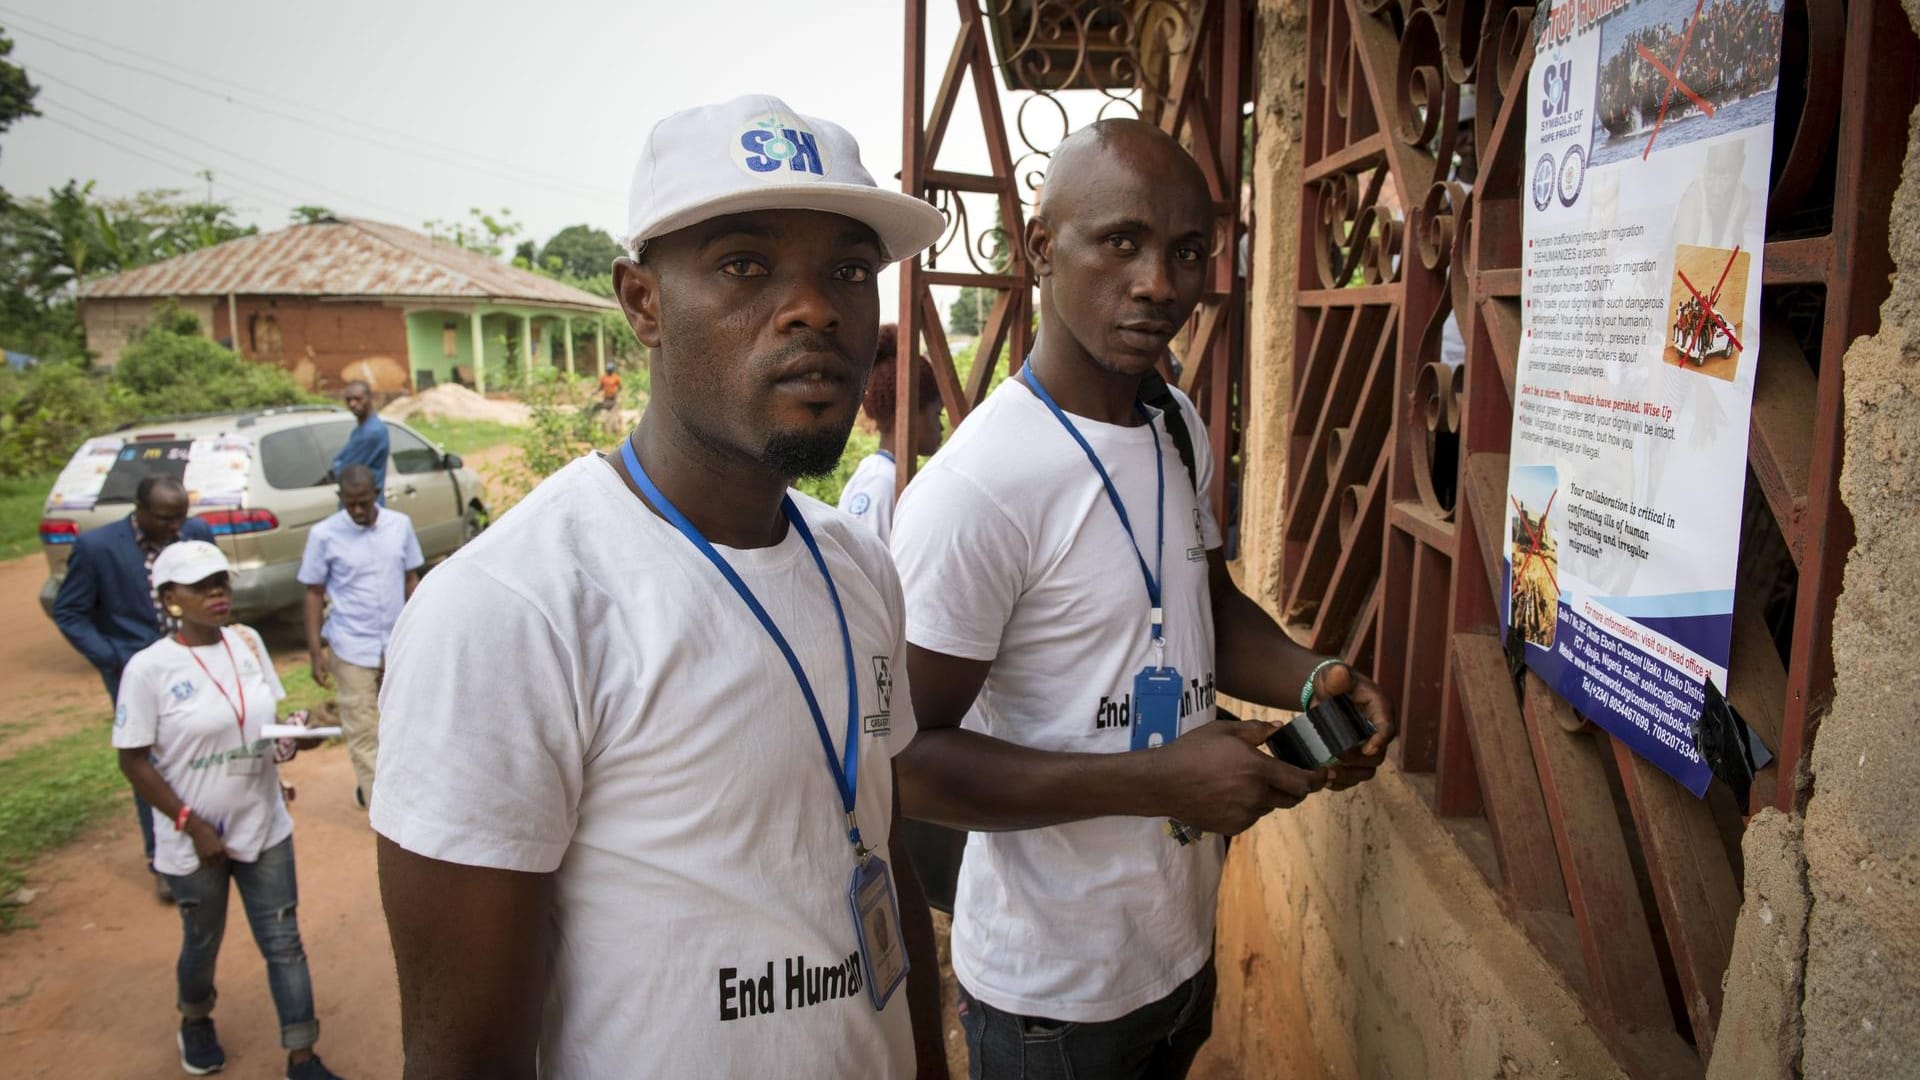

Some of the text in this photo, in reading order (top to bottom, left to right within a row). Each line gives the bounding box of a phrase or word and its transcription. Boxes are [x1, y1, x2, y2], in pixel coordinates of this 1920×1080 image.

[1541, 109, 1584, 131] SYMBOLS OF
[1540, 125, 1582, 144] HOPE PROJECT
[1611, 224, 1644, 241] migration
[1534, 248, 1577, 263] DEHUMANIZES
[1579, 264, 1592, 275] and
[1592, 261, 1622, 277] irregular
[1623, 258, 1657, 276] migration
[1571, 298, 1591, 311] dignity
[1592, 297, 1605, 308] with
[1606, 297, 1623, 309] such
[1625, 296, 1664, 312] dangerous
[1560, 313, 1573, 325] Your
[1574, 314, 1594, 328] dignity
[1602, 315, 1617, 328] your
[1547, 362, 1571, 374] pastures
[1576, 347, 1584, 361] by
[1585, 347, 1617, 361] traffickers
[1618, 349, 1638, 363] about
[1563, 390, 1594, 405] Thousands
[1596, 394, 1611, 408] have
[1612, 398, 1640, 413] perished.
[1643, 402, 1660, 417] Wise
[1662, 405, 1672, 422] Up
[1562, 424, 1572, 435] not
[1597, 429, 1607, 443] but
[1608, 432, 1620, 446] how
[1621, 437, 1633, 450] you
[1584, 412, 1596, 424] and
[1597, 414, 1612, 427] your
[1612, 415, 1632, 433] dignity
[1632, 420, 1643, 433] will
[1644, 420, 1653, 435] be
[1654, 423, 1676, 440] intact.
[1561, 438, 1574, 454] legal
[1567, 502, 1650, 541] confronting ills of human
[1585, 488, 1628, 513] collaboration
[1629, 501, 1636, 514] is
[1637, 507, 1666, 525] critical
[1666, 515, 1675, 529] in
[1568, 519, 1649, 561] trafficking and irregular
[1592, 609, 1604, 623] more
[1604, 613, 1640, 642] information:
[1641, 632, 1656, 650] visit
[1656, 643, 1668, 656] our
[1668, 645, 1685, 666] head
[1685, 656, 1703, 677] office
[1704, 668, 1712, 679] at
[1573, 634, 1584, 650] FCT
[1623, 664, 1641, 687] Email:
[1640, 679, 1702, 721] sohlccn@gmail.co
[1600, 634, 1616, 653] Eboh
[1617, 642, 1643, 668] Crescent
[1642, 656, 1662, 681] Utako,
[1664, 667, 1684, 691] Utako
[1684, 679, 1705, 704] Distric
[1096, 693, 1130, 729] End
[1652, 722, 1700, 763] 7082073346
[719, 961, 775, 1021] End
[785, 950, 863, 1011] Human
